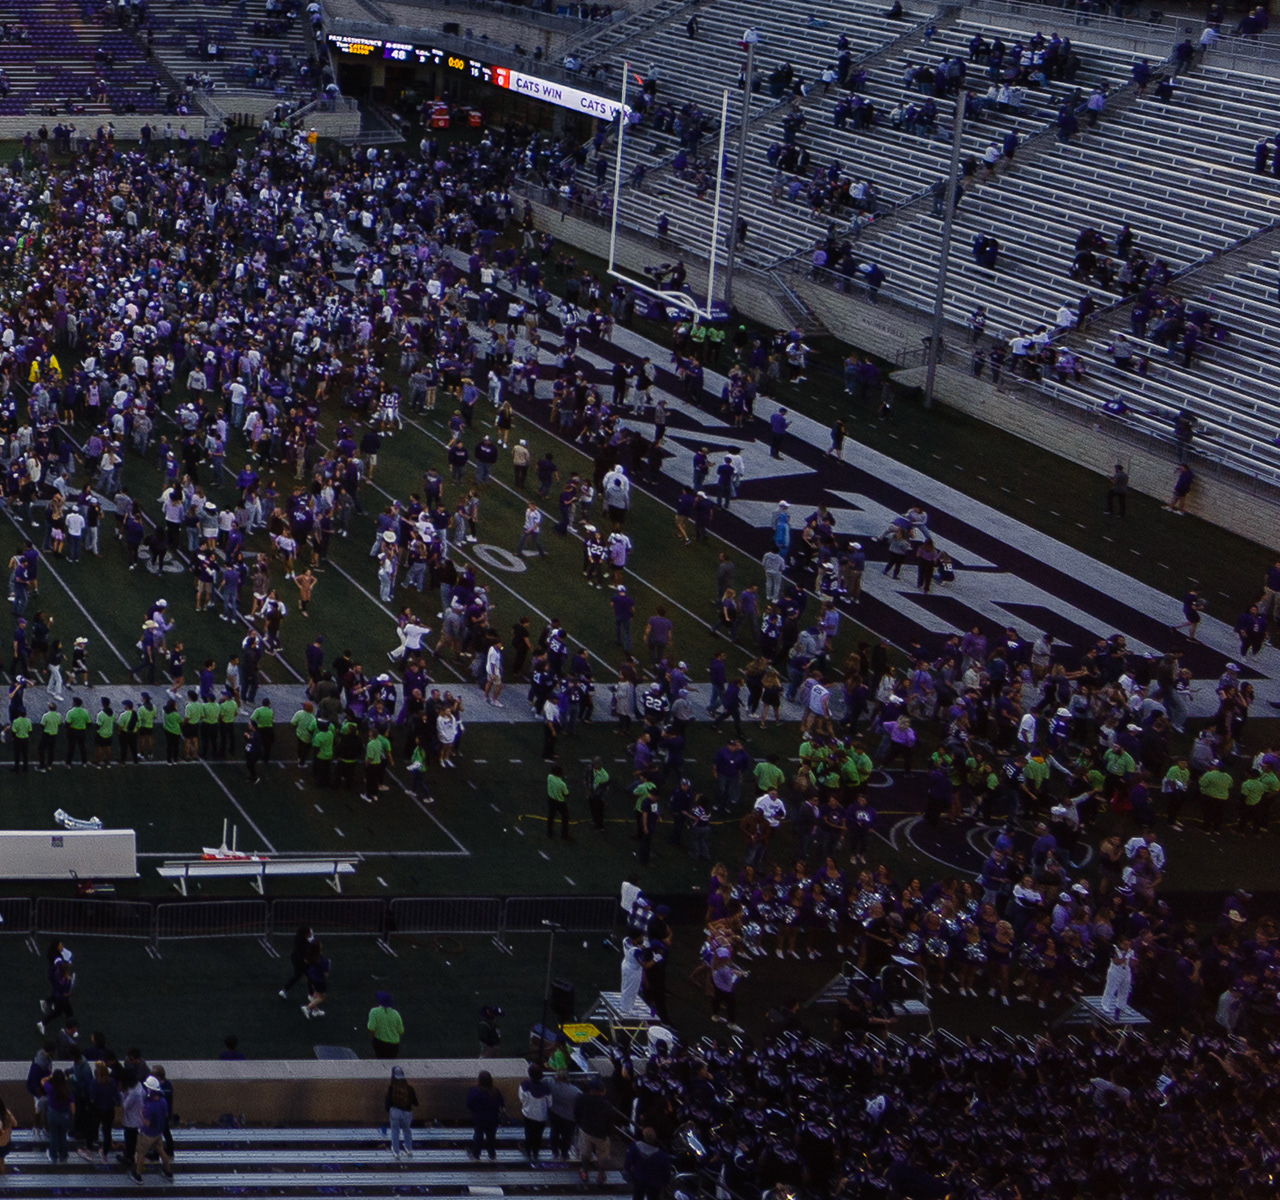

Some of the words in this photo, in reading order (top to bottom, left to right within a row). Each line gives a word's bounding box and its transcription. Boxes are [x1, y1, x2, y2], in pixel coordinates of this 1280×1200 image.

[391, 50, 406, 60] 48
[448, 56, 465, 70] 0:00
[516, 78, 540, 94] CATS
[542, 85, 562, 100] WIN
[580, 97, 606, 114] CATS
[591, 543, 604, 556] 22
[646, 695, 662, 711] 22
